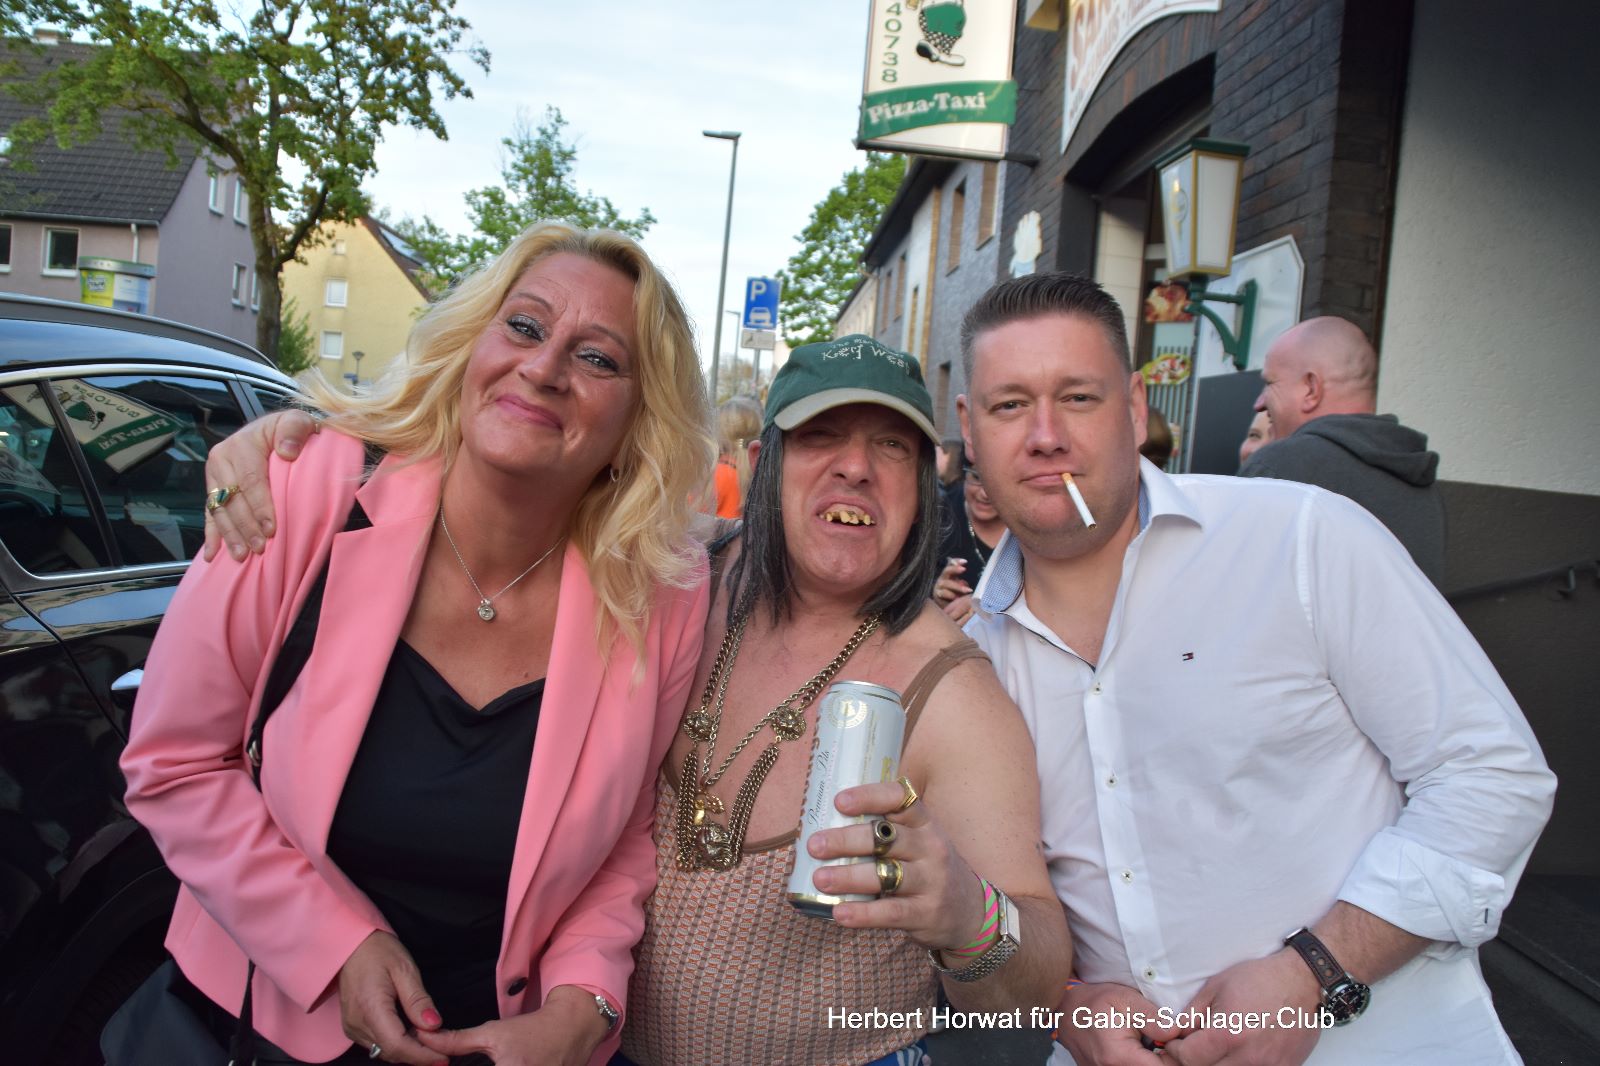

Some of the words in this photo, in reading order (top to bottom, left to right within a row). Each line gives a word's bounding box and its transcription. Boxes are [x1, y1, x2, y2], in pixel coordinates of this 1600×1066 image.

[867, 91, 986, 125] Pizza-Taxi
[750, 280, 767, 302] P
[808, 780, 826, 825] Premium
